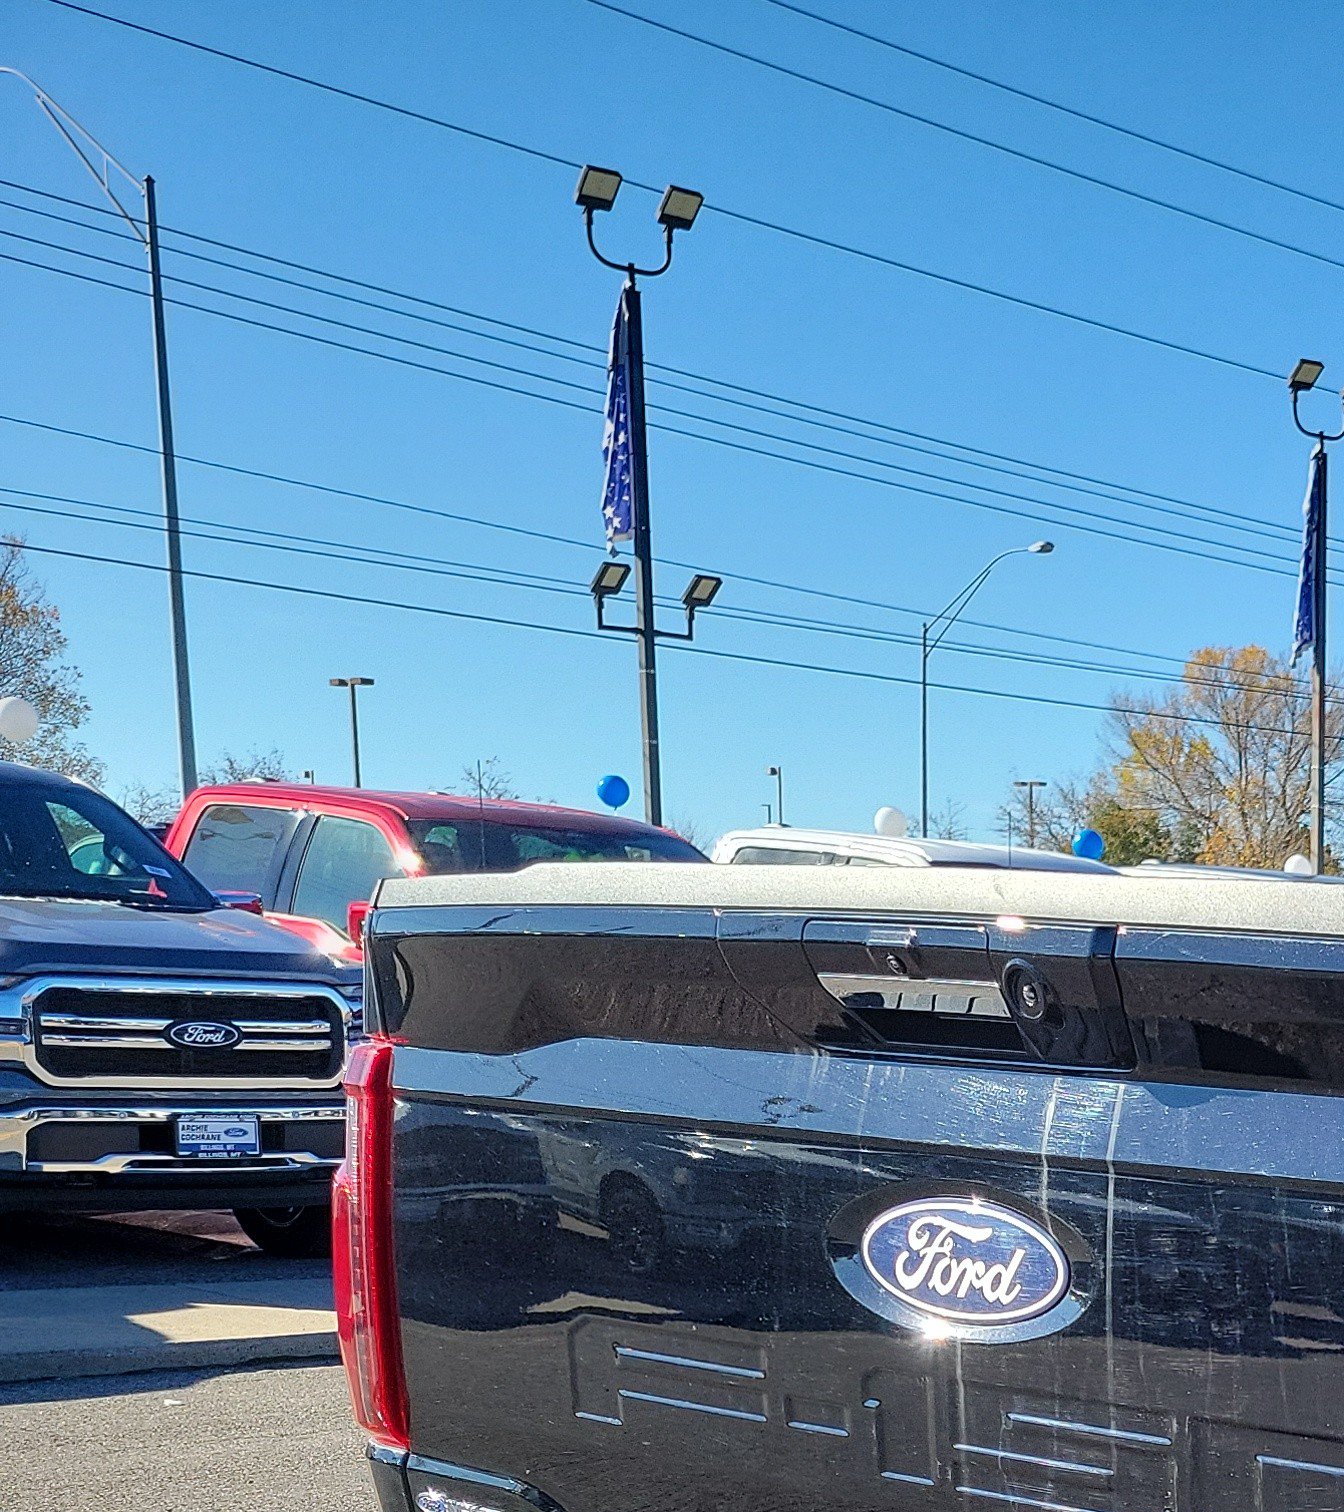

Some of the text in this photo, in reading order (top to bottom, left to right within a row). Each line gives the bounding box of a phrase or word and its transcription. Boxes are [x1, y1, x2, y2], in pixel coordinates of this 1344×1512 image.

[184, 1025, 226, 1042] Ford
[181, 1133, 221, 1141] COCHRANE
[895, 1215, 1026, 1306] Ford
